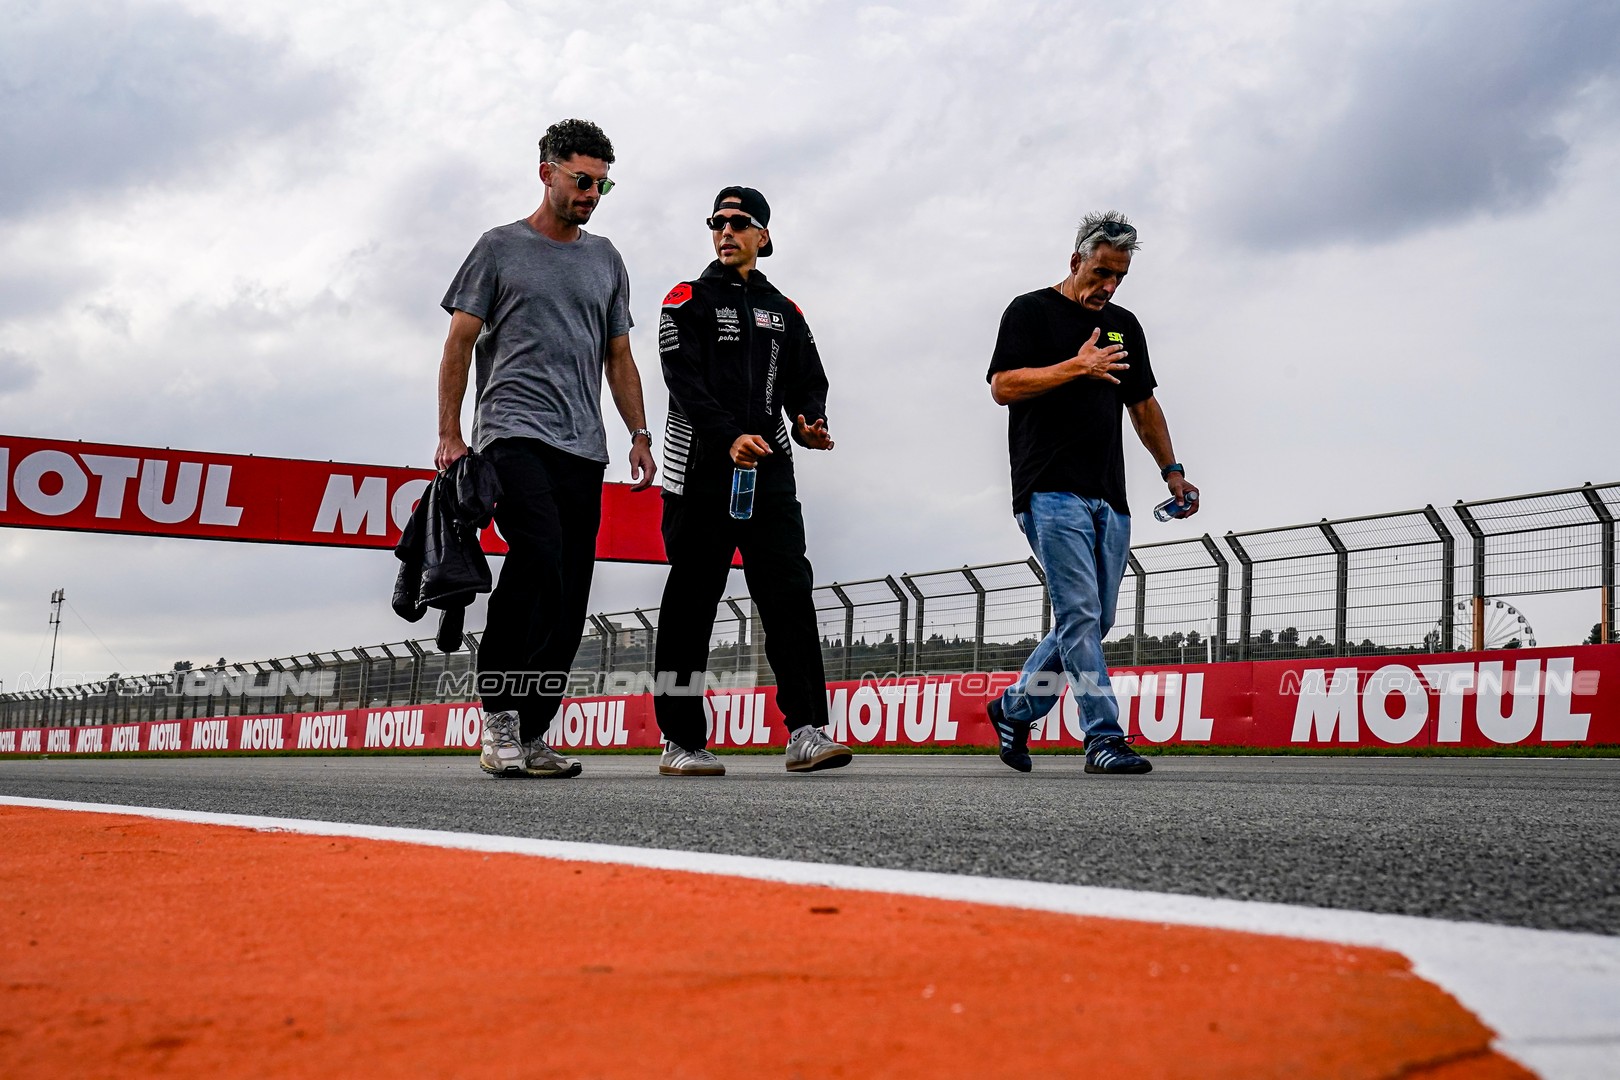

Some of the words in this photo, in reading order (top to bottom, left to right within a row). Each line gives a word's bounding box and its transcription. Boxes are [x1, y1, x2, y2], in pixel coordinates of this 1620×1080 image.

[0, 447, 243, 527] OTUL
[1291, 657, 1592, 744] MOTUL
[240, 718, 284, 750] MOTUL
[297, 714, 348, 749] MOTUL
[364, 710, 425, 748] MOTUL
[703, 693, 771, 746] TUL
[0, 731, 16, 752] OTUL
[20, 730, 41, 752] MOTUL
[47, 729, 70, 752] MOTUL
[76, 728, 103, 752] MOTUL
[110, 726, 140, 752] MOTUL
[148, 723, 182, 751] MOTUL
[191, 720, 229, 750] MOTUL
